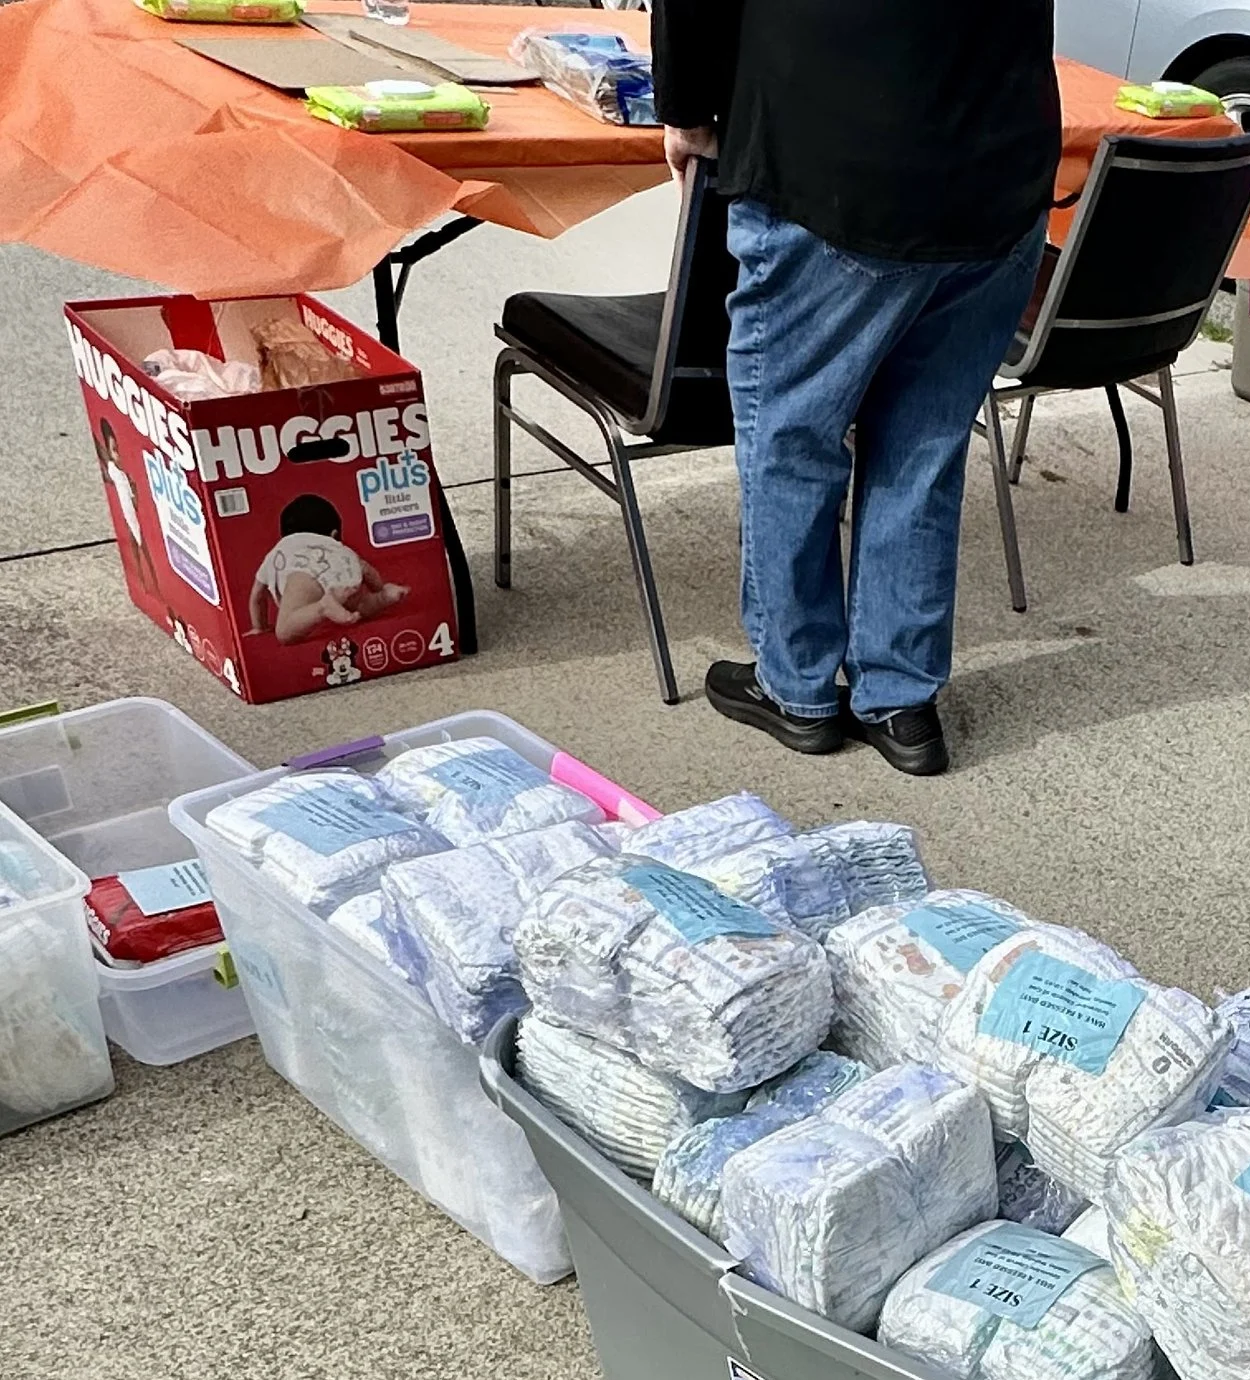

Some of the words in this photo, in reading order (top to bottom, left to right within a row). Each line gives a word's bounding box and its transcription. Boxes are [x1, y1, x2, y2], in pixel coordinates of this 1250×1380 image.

[64, 315, 196, 471] HUGGIES
[192, 403, 430, 483] HUGGIES
[428, 622, 455, 657] 4
[221, 657, 242, 696] 4
[1038, 1025, 1077, 1051] SIZE
[1085, 1016, 1105, 1028] HAVE
[984, 1284, 1022, 1306] SIZE
